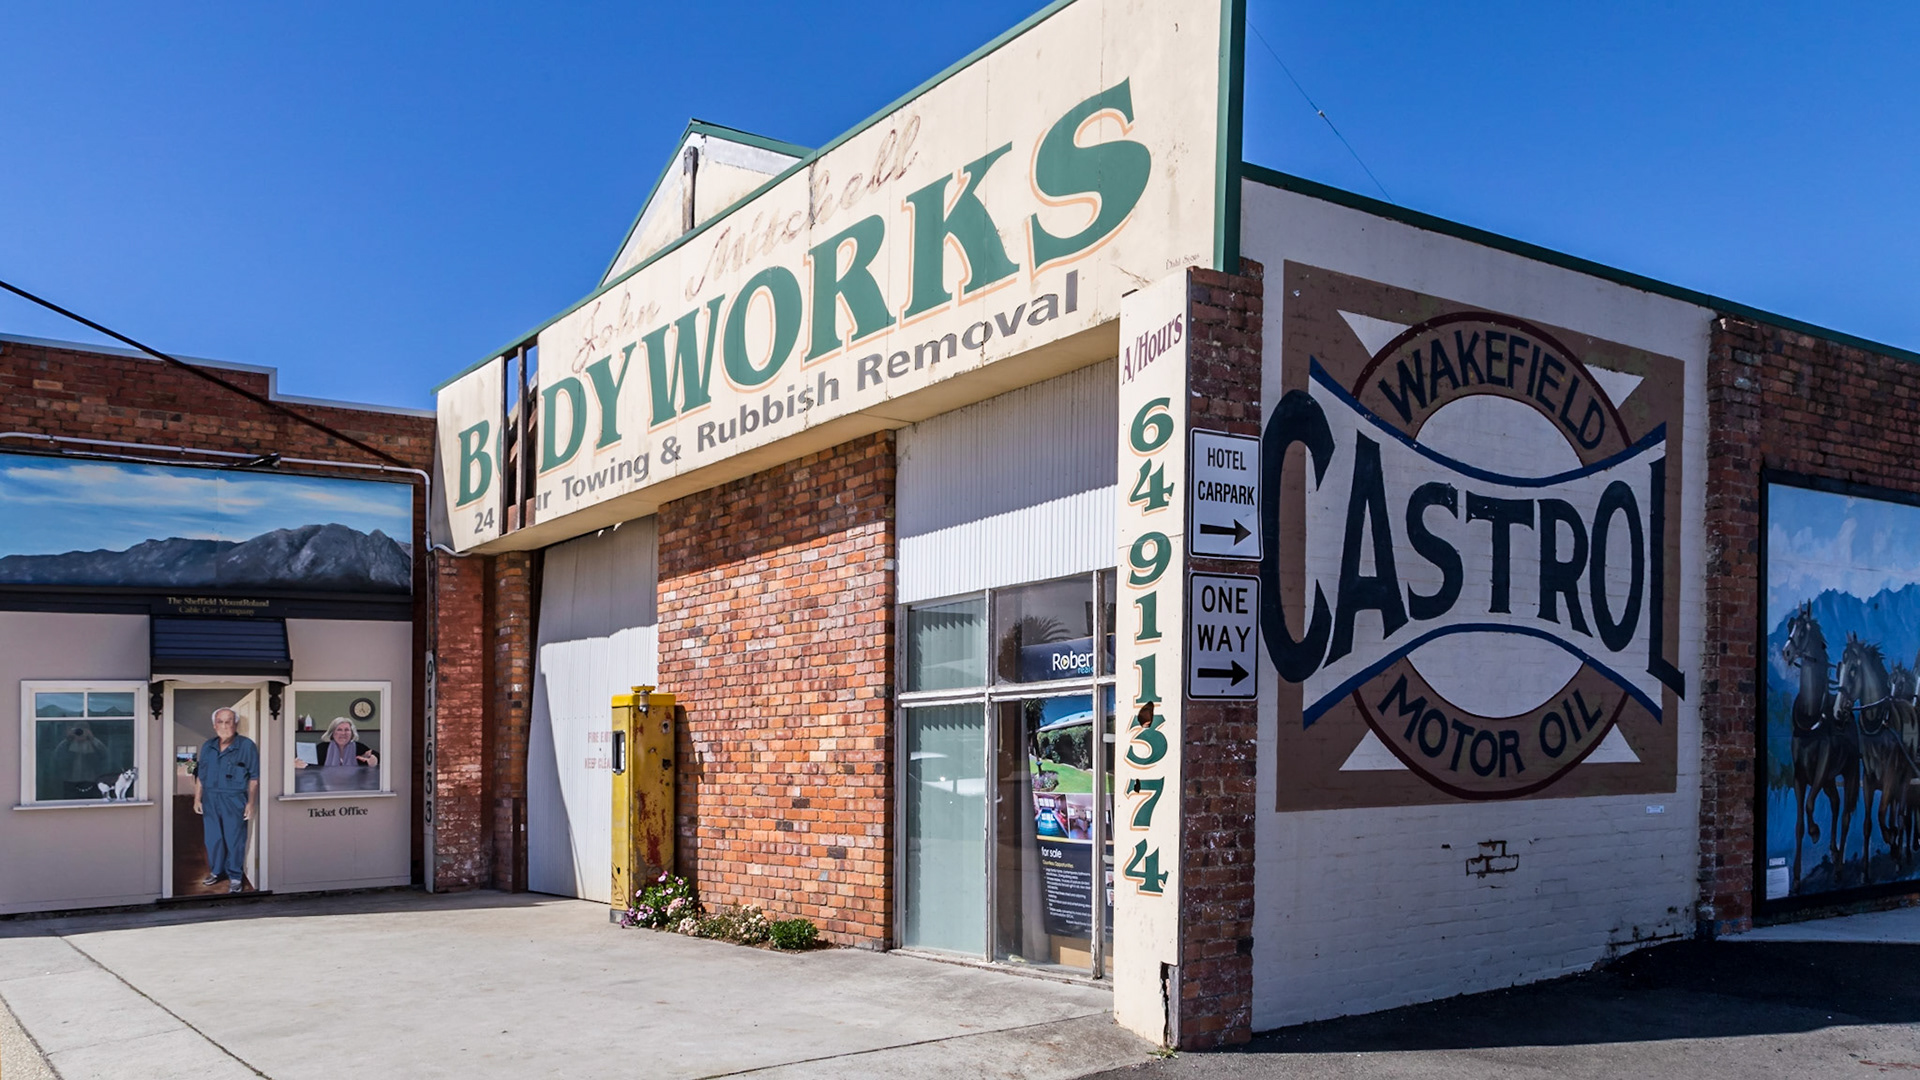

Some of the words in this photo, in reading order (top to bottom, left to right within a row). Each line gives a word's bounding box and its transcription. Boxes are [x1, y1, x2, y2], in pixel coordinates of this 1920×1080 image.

[455, 76, 1153, 511] BDYWORKS
[1122, 313, 1183, 385] A/Hours
[474, 508, 495, 534] 24
[562, 451, 650, 500] Towing
[660, 436, 682, 465] &
[697, 371, 839, 453] Rubbish
[857, 270, 1079, 391] Removal
[1378, 329, 1605, 451] WAKEFIELD
[1207, 446, 1247, 472] HOTEL
[1198, 480, 1255, 506] CARPARK
[1259, 388, 1685, 701] CASTROL
[166, 597, 182, 605] The
[184, 597, 217, 606] Sheffield
[1201, 584, 1249, 614] ONE
[1197, 624, 1251, 652] WAY
[1376, 672, 1526, 778] MOTOR
[1539, 688, 1604, 759] OIL
[307, 807, 337, 819] Ticket
[339, 806, 369, 817] Office
[1041, 846, 1049, 857] for
[1049, 849, 1062, 859] sale
